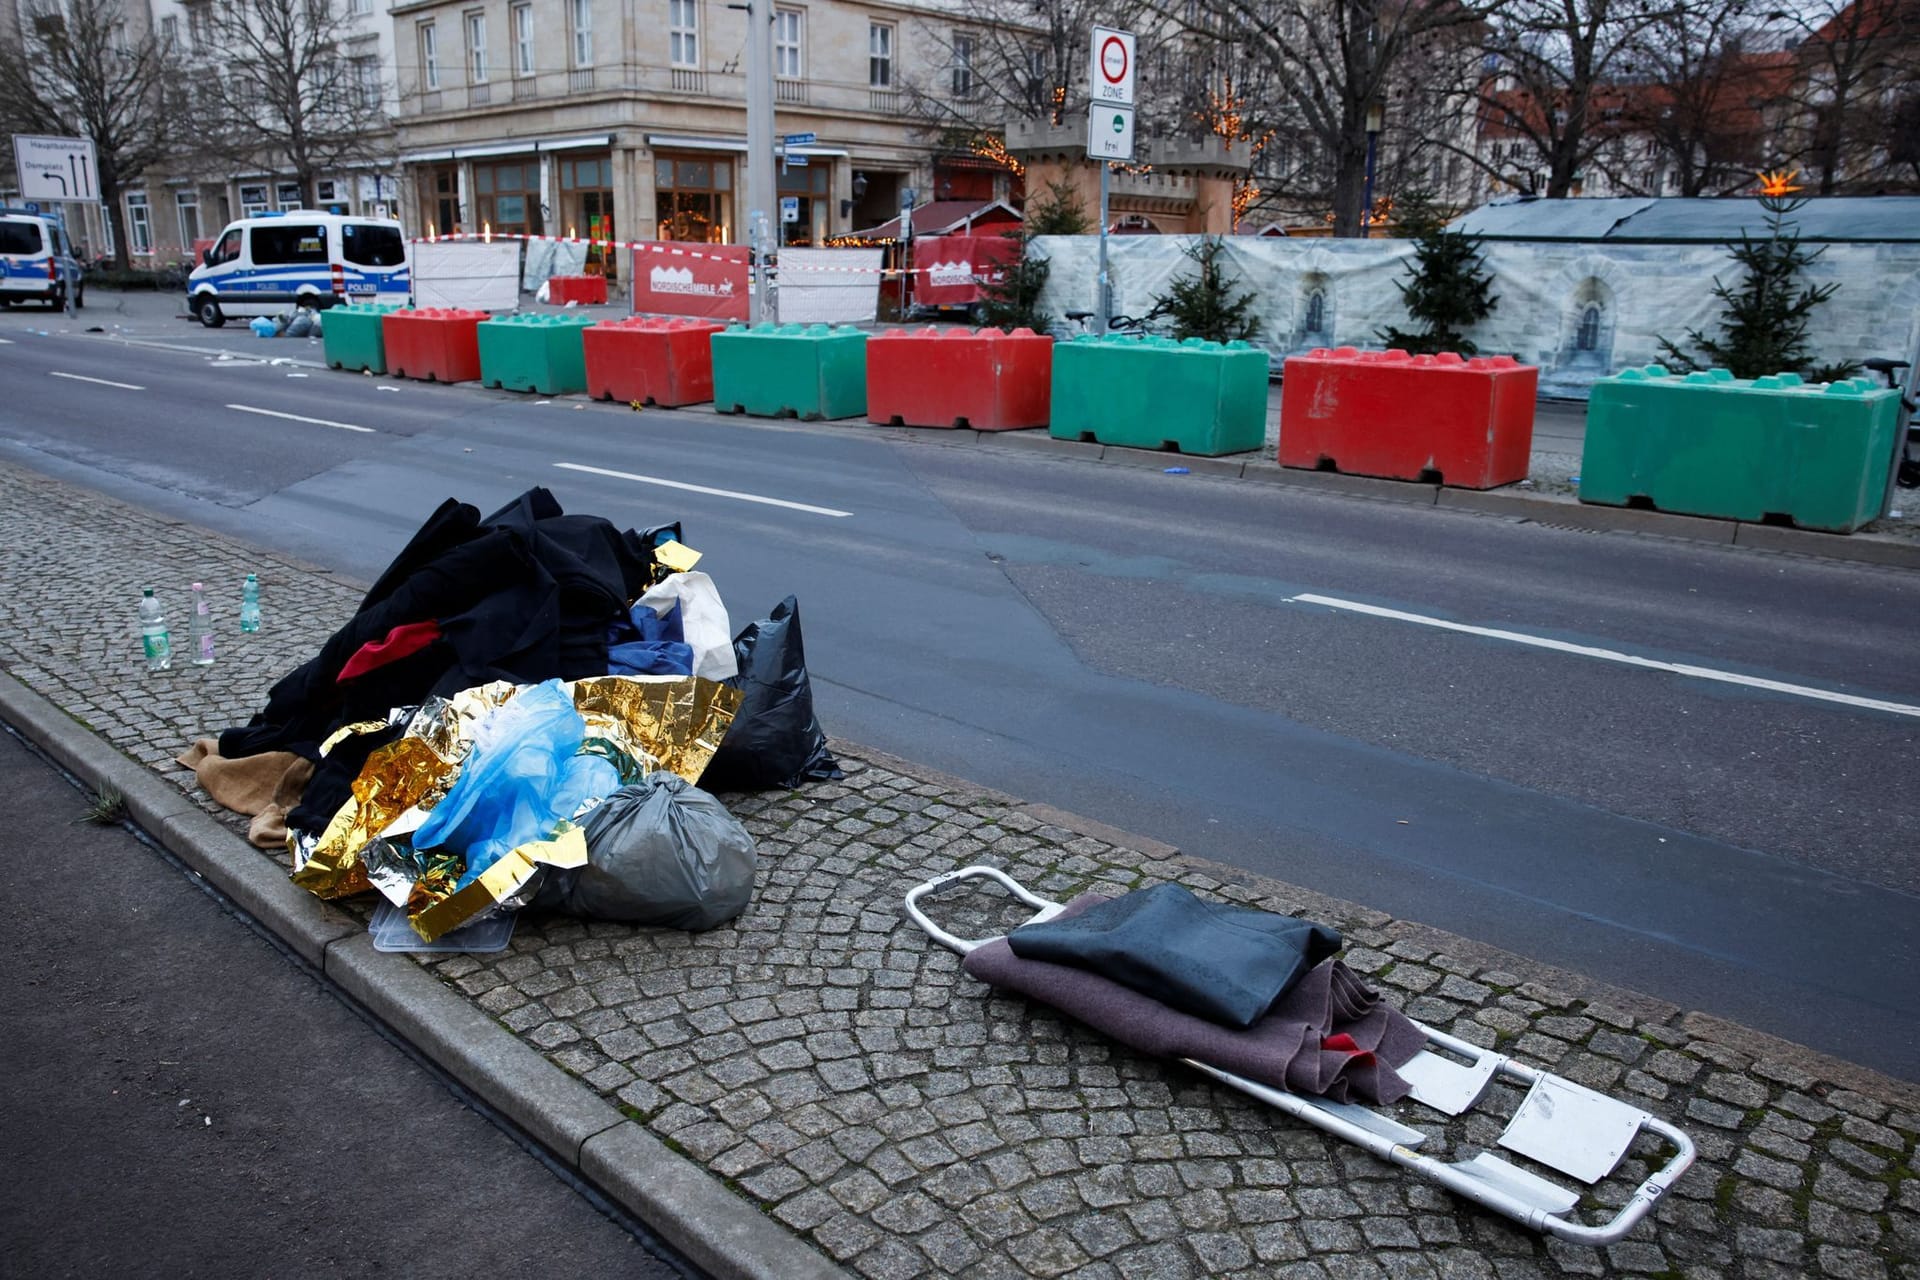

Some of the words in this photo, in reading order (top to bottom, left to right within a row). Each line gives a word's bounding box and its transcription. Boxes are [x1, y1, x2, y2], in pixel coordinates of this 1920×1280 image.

[1102, 85, 1124, 99] ZONE
[30, 141, 87, 151] Hauptbahnhof
[1104, 140, 1119, 152] frei
[348, 283, 377, 291] POLIZEI
